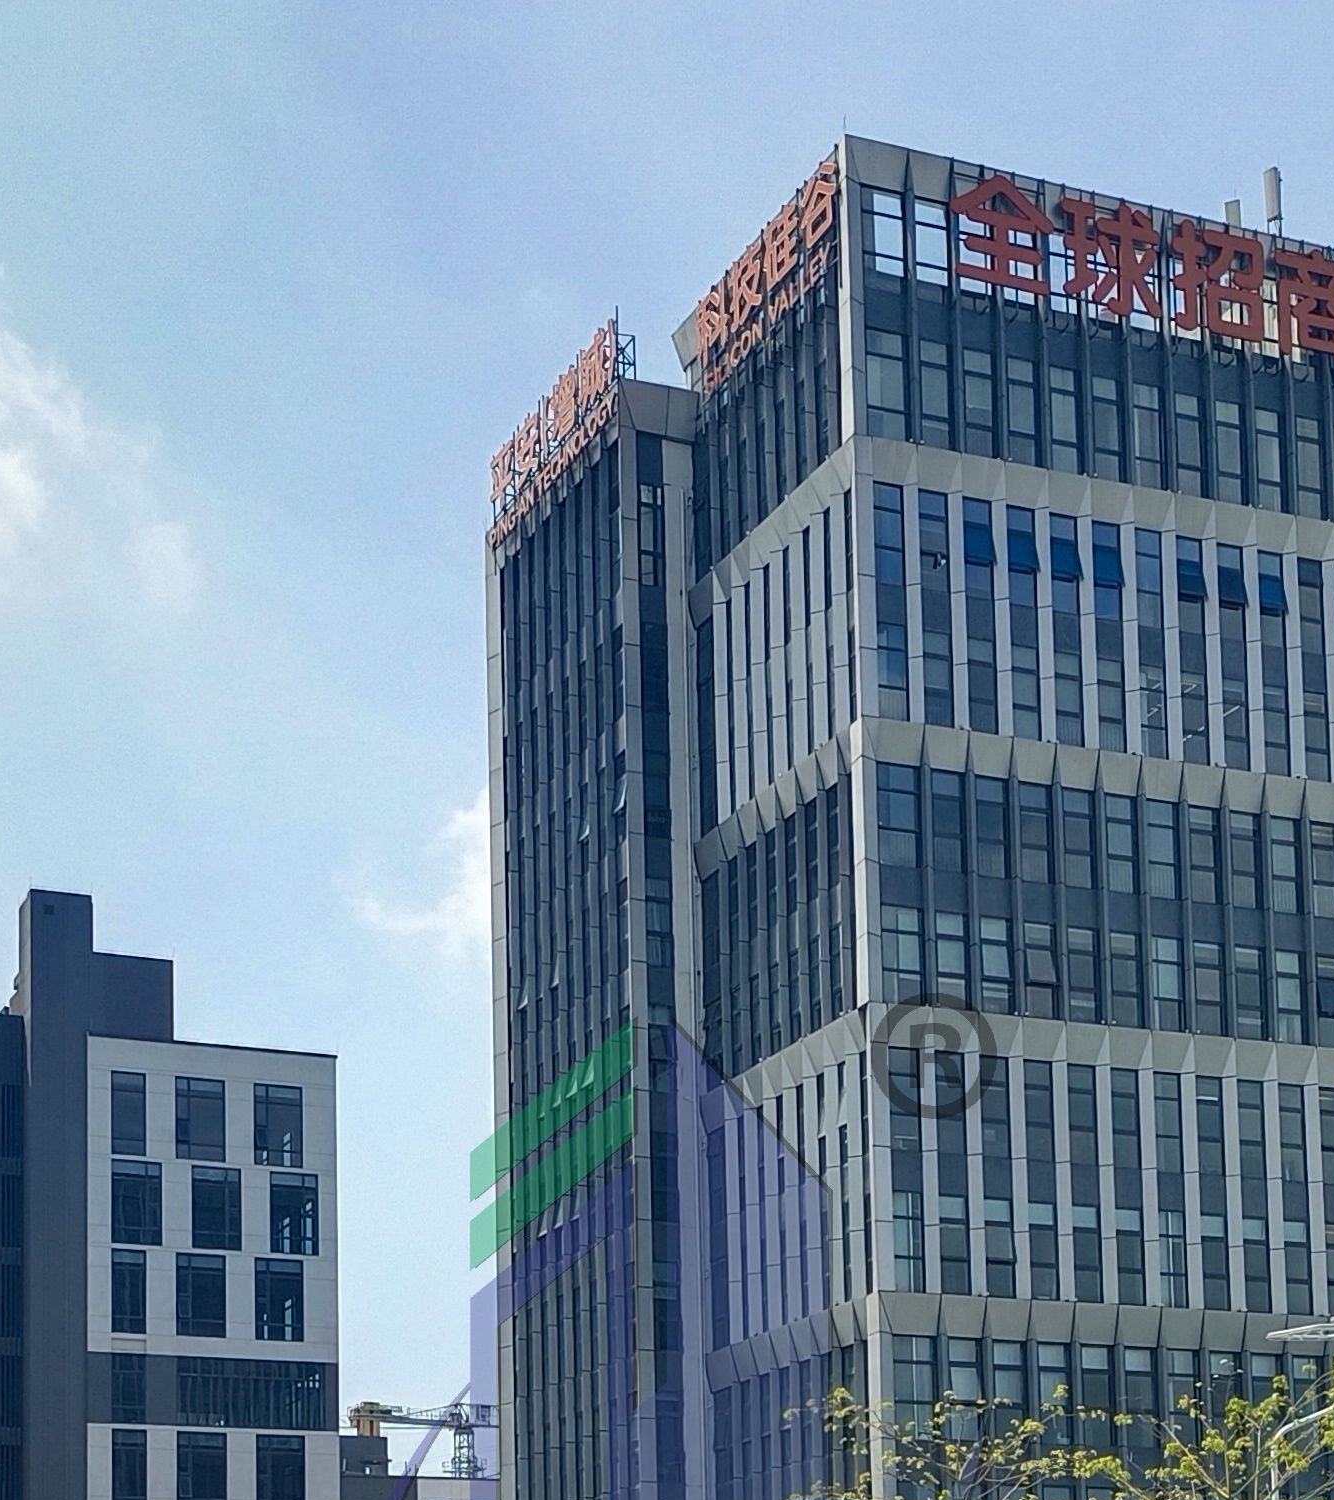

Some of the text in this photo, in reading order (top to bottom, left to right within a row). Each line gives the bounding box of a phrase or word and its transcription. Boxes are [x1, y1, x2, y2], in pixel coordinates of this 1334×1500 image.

[696, 162, 836, 366] 科技硅谷
[768, 241, 830, 325] VALLEY
[535, 393, 618, 495] TECHNOLOGY
